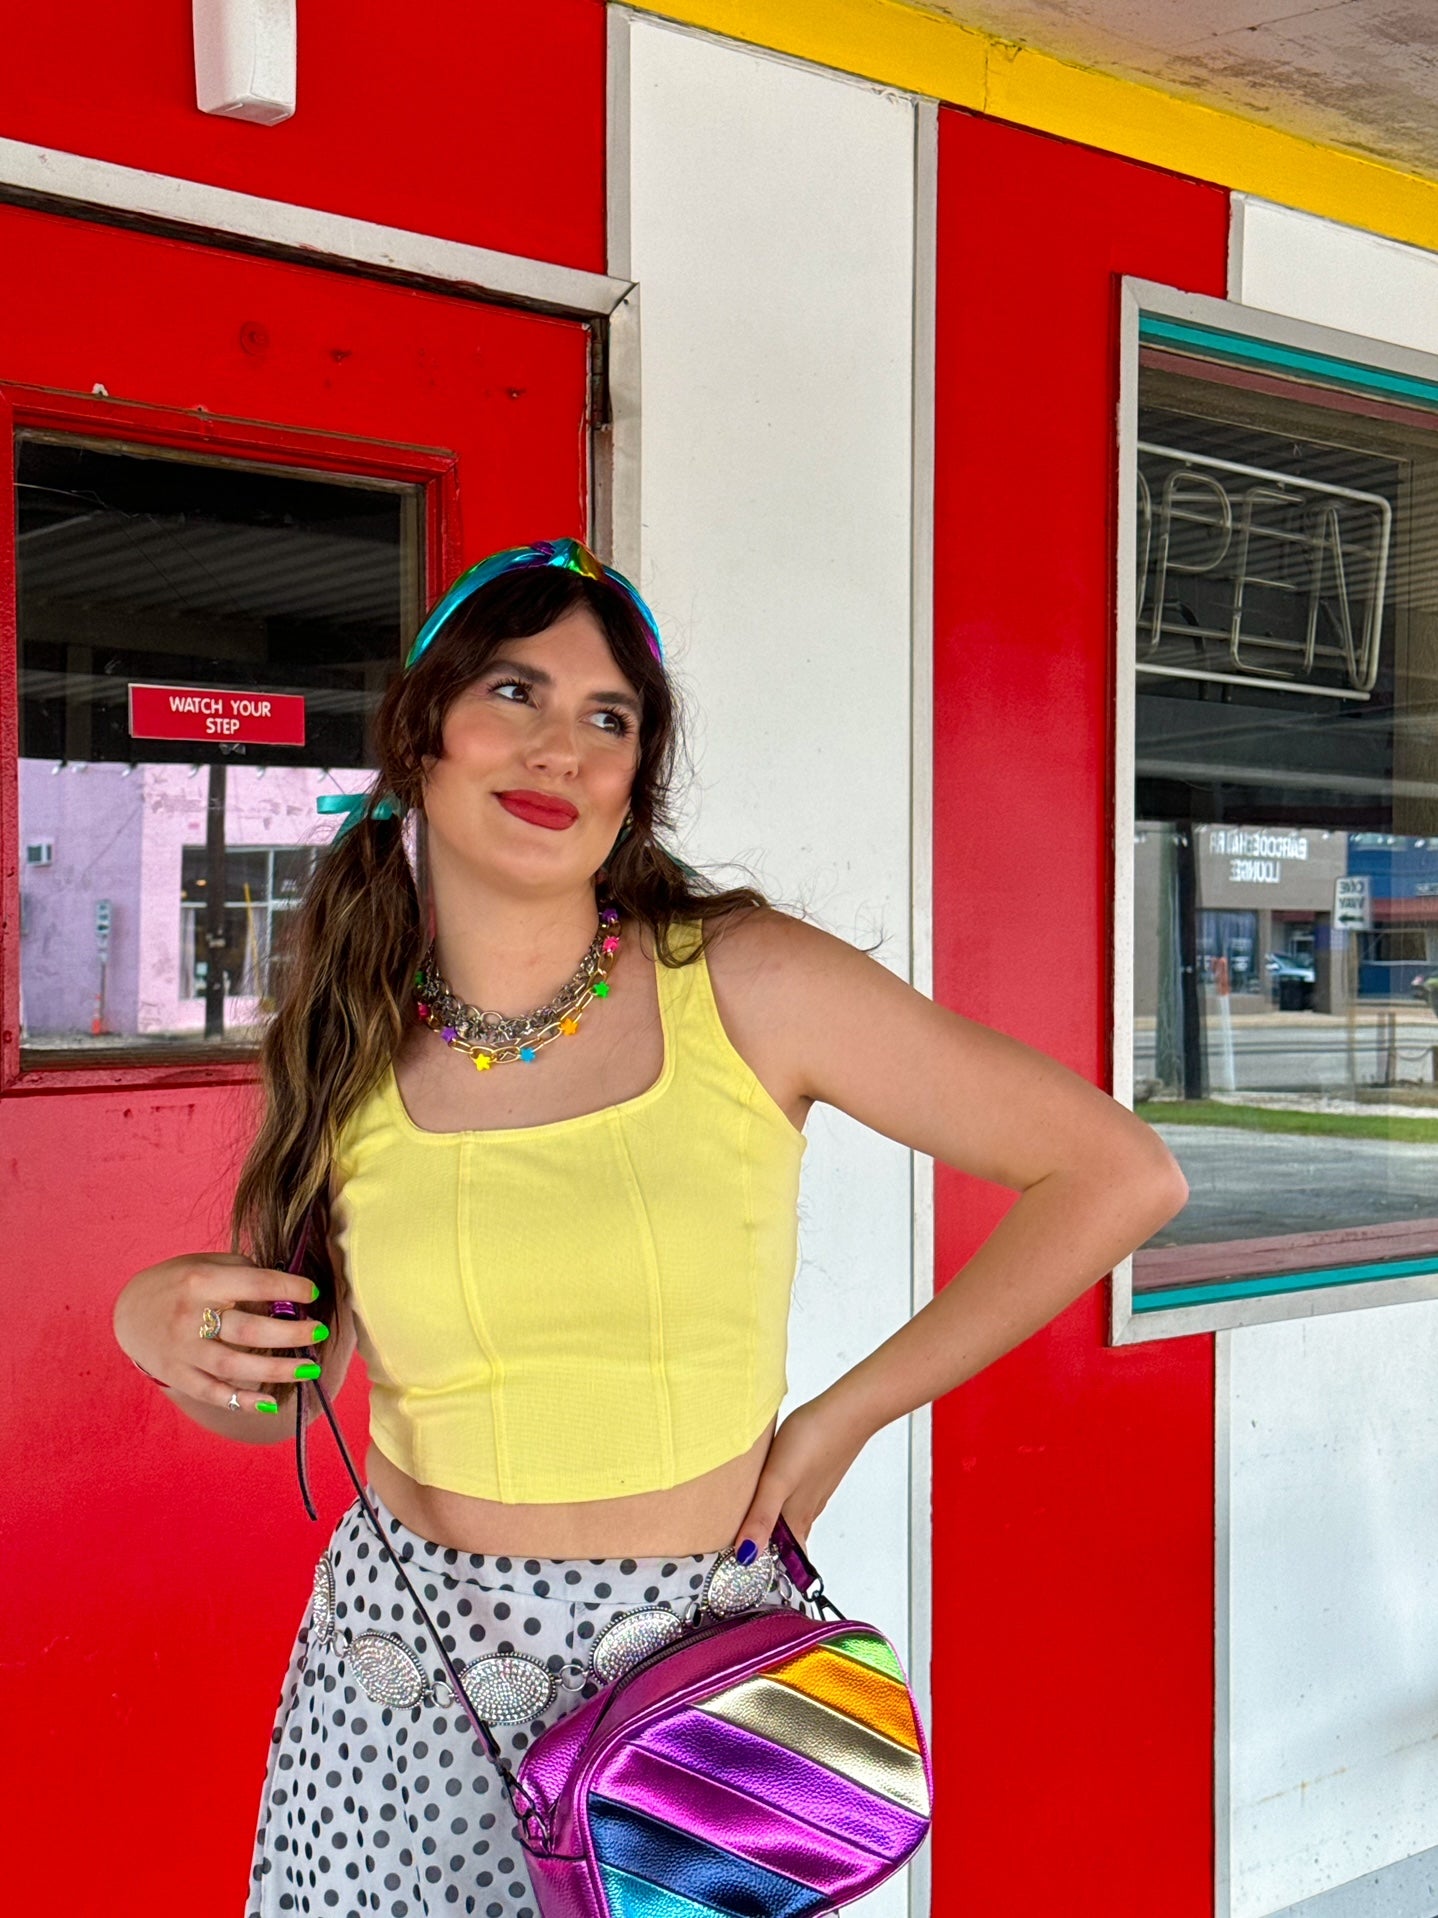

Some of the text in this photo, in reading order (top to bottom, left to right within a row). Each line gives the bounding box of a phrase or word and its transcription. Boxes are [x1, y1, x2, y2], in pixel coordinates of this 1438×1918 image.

[169, 696, 271, 717] WATCH YOUR
[206, 718, 240, 734] STEP
